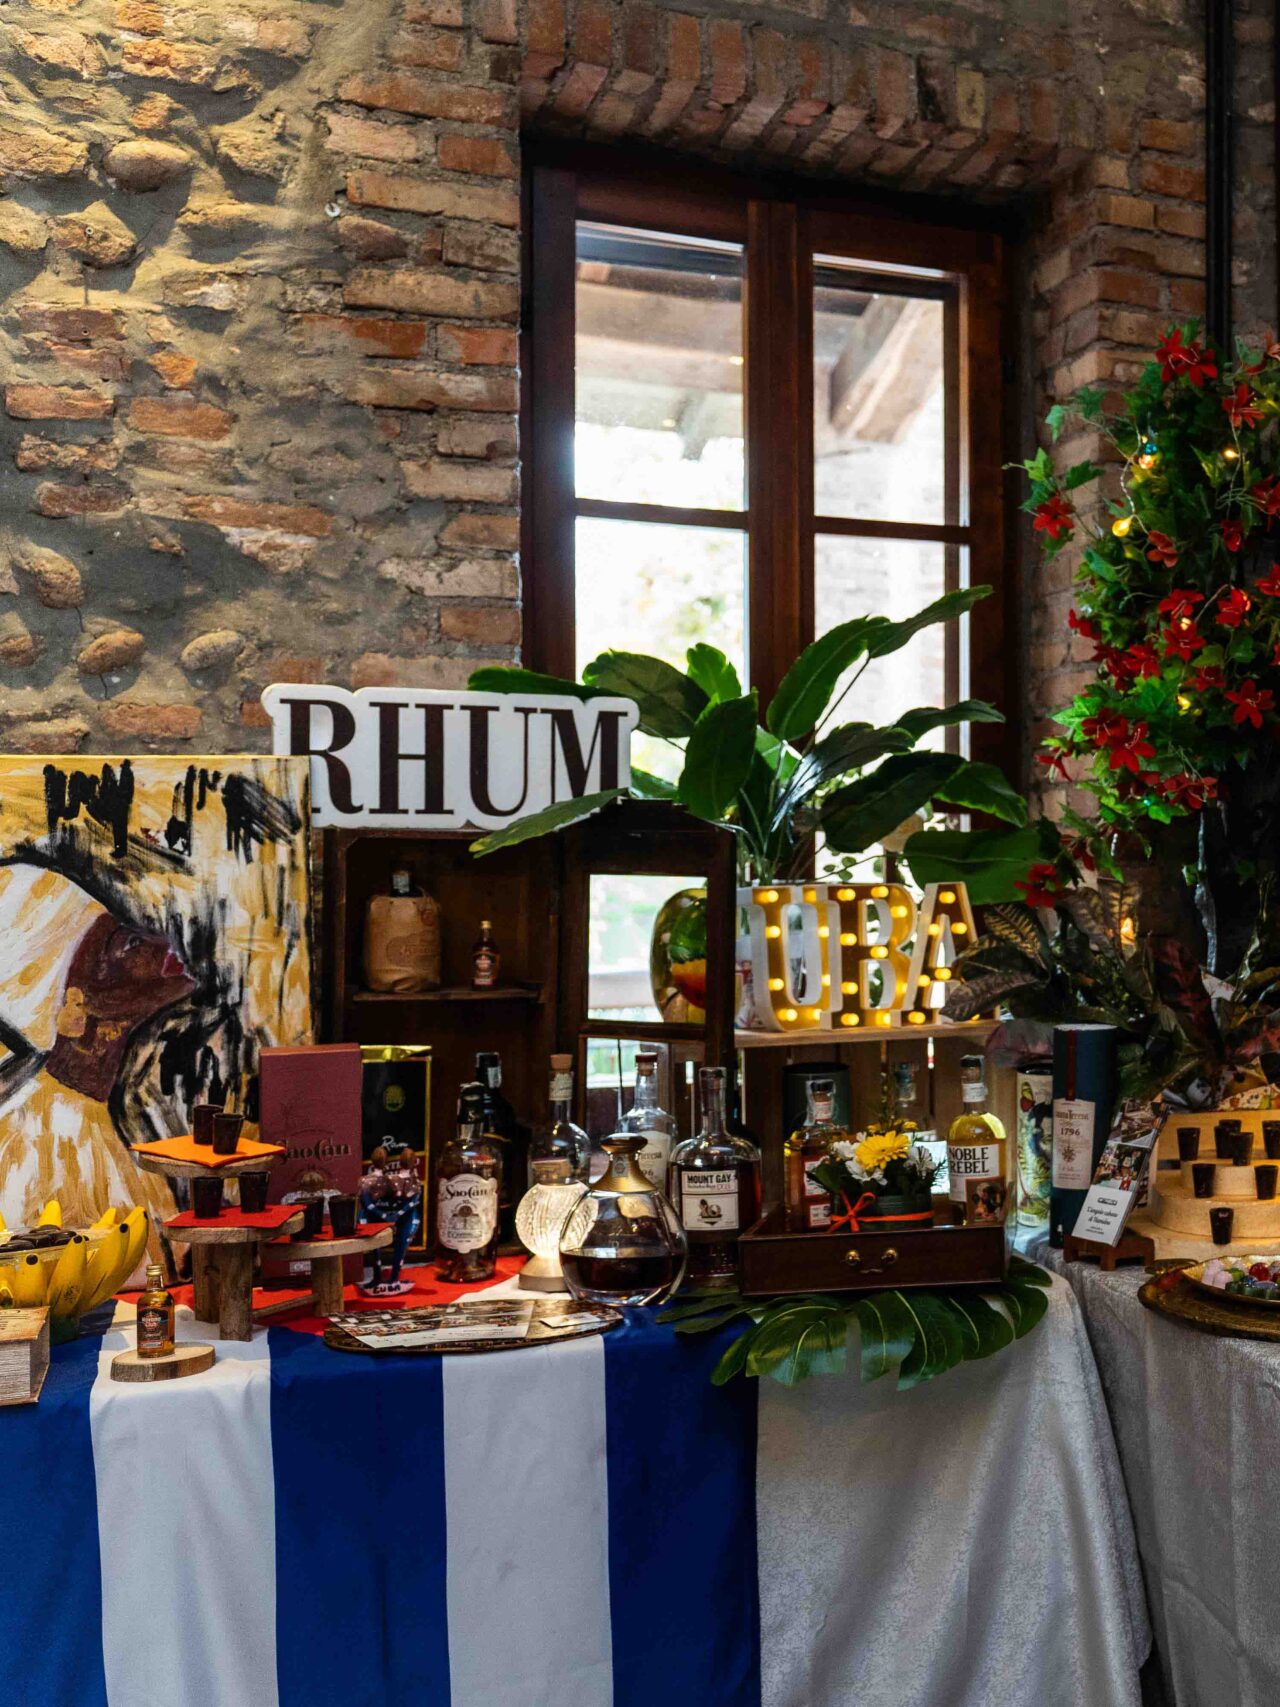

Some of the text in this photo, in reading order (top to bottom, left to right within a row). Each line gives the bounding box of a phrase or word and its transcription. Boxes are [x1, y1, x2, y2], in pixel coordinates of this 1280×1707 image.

[279, 697, 629, 818] RHUM
[1060, 1127, 1081, 1137] 1796
[948, 1147, 990, 1160] NOBLE
[949, 1160, 990, 1174] REBEL
[687, 1173, 732, 1184] MOUNT GAY
